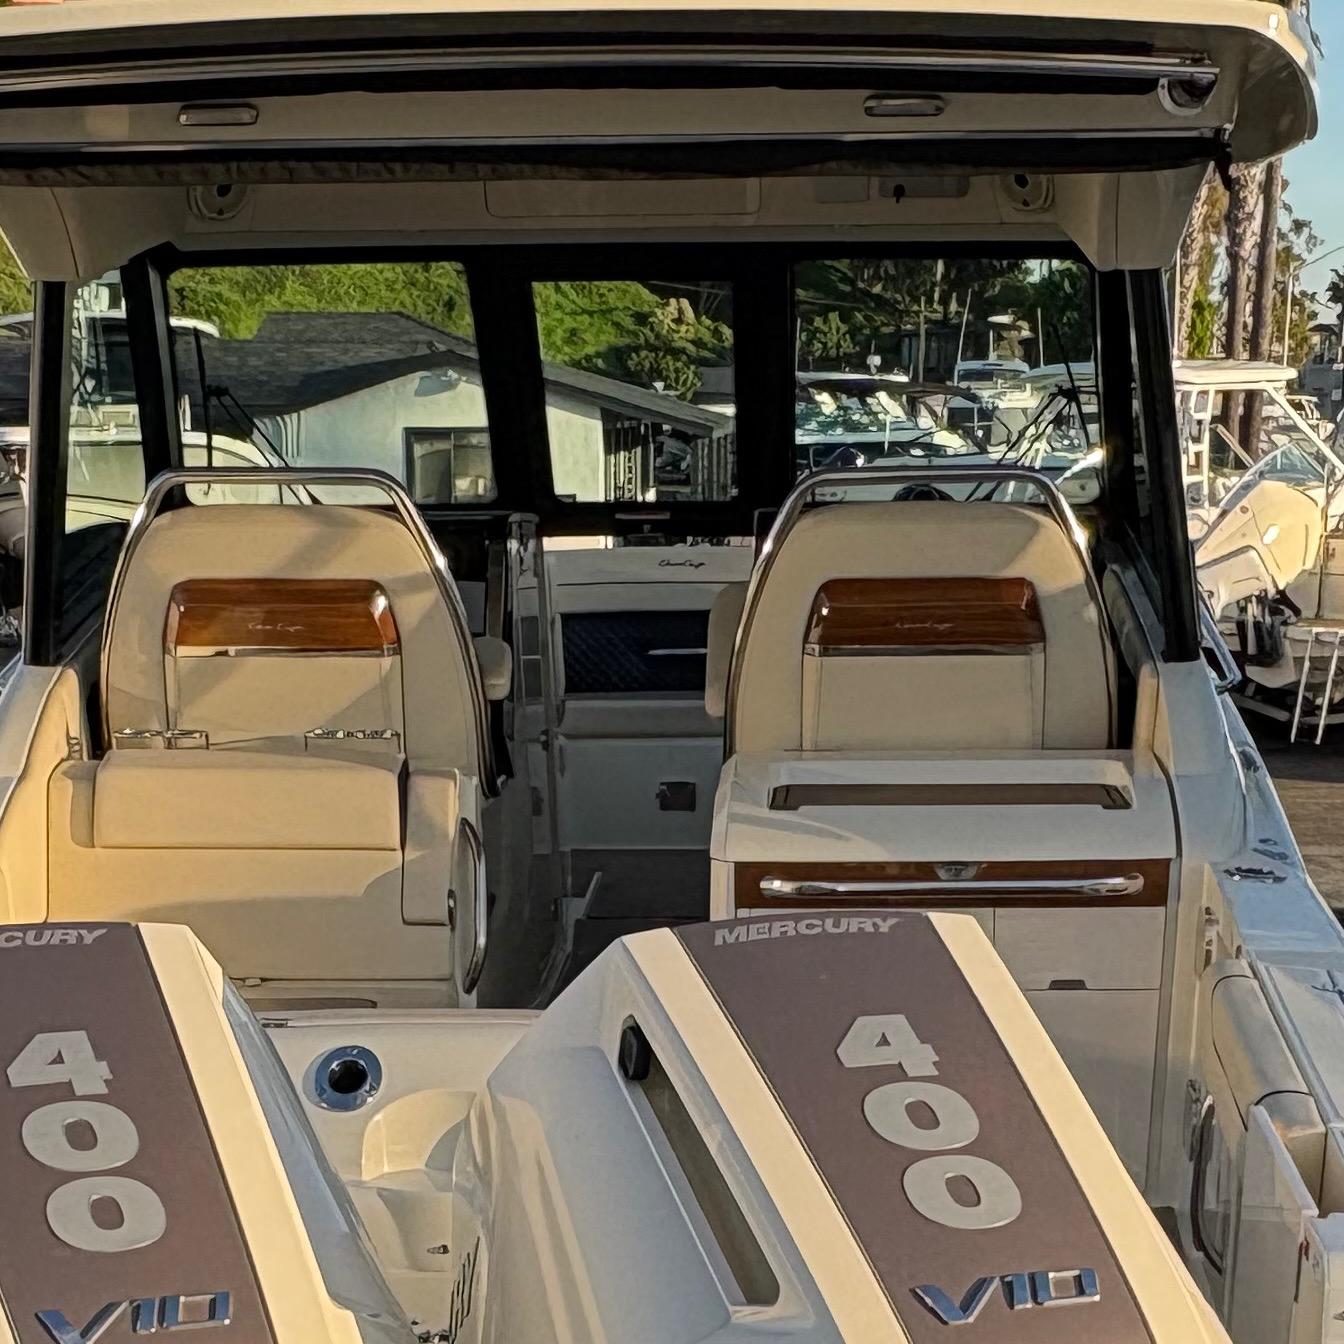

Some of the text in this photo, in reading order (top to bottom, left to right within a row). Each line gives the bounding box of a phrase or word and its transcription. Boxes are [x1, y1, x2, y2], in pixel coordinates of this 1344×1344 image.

[714, 917, 900, 946] MERCURY
[6, 1030, 167, 1252] 400
[837, 1014, 1022, 1229] 400
[909, 1268, 1100, 1325] V10
